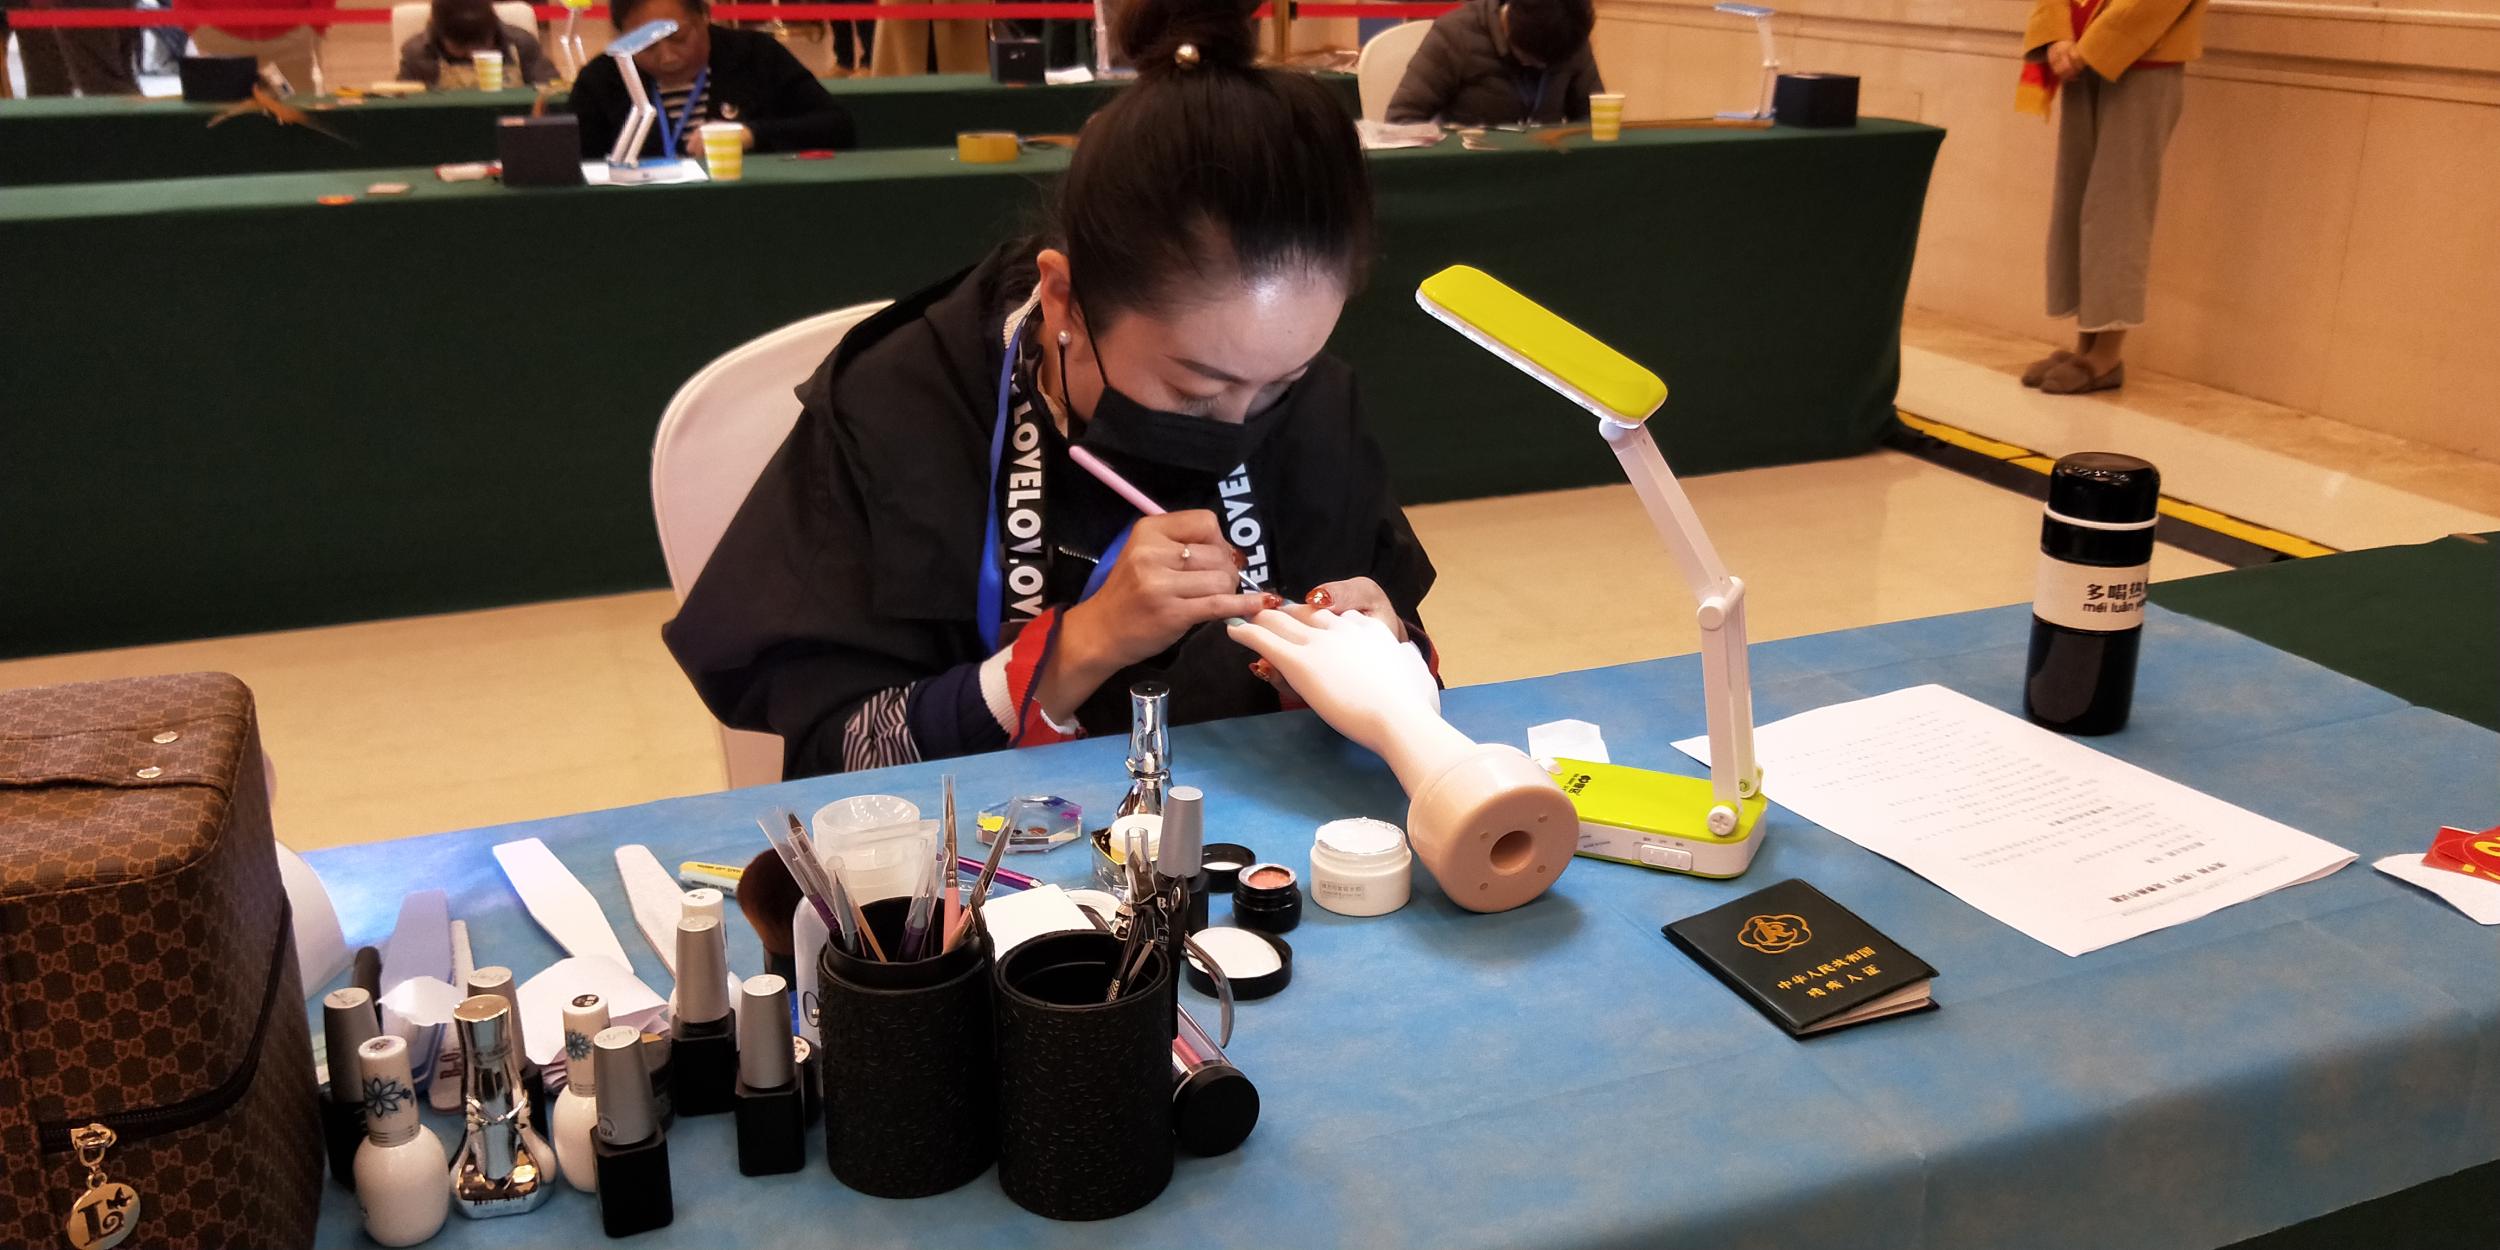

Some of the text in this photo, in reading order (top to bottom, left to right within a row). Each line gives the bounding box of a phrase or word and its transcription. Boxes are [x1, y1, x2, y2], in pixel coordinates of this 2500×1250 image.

[1777, 946, 1876, 990] 中华人民共和国
[1807, 964, 1881, 998] 残疾人证
